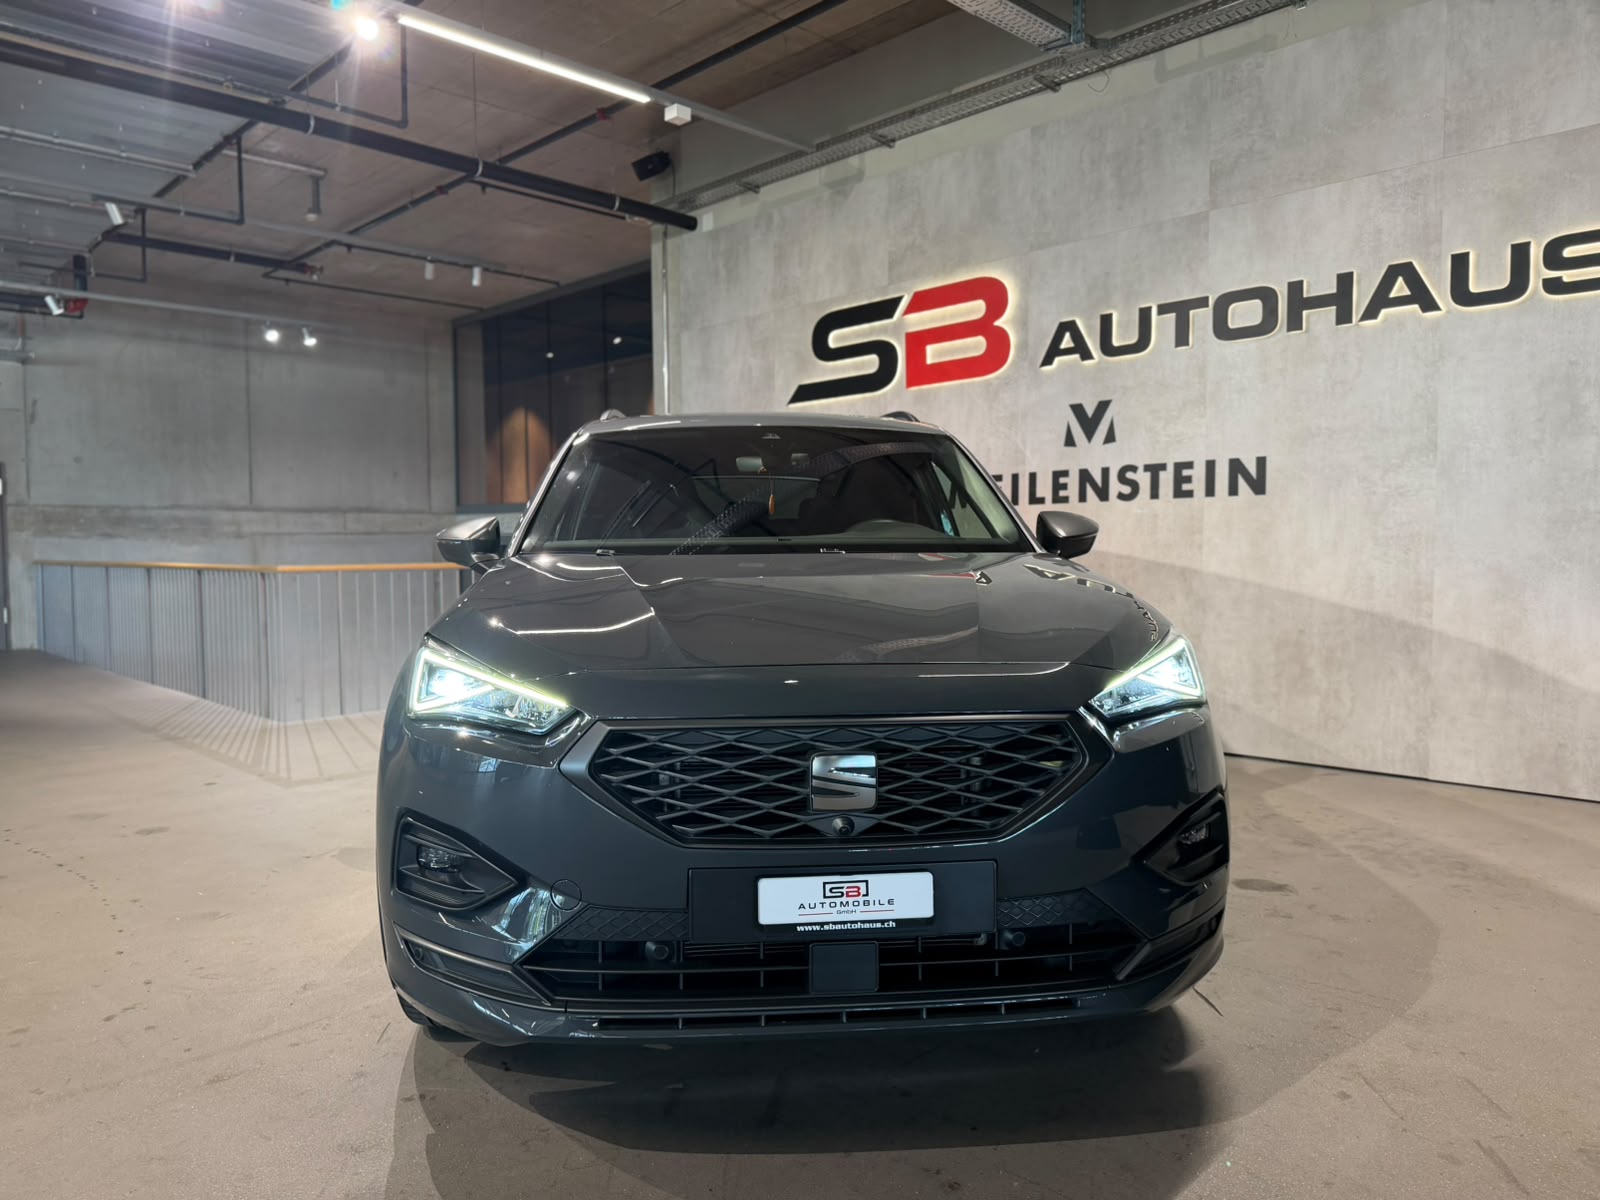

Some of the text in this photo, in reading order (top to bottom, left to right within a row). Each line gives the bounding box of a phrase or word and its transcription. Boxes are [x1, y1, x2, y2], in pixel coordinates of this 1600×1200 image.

[786, 228, 1600, 406] SB AUTOHAUS
[1063, 399, 1117, 448] M
[828, 885, 862, 898] SB
[798, 898, 896, 911] AUTOMOBILE
[796, 920, 896, 932] www.sbautohaus.ch
